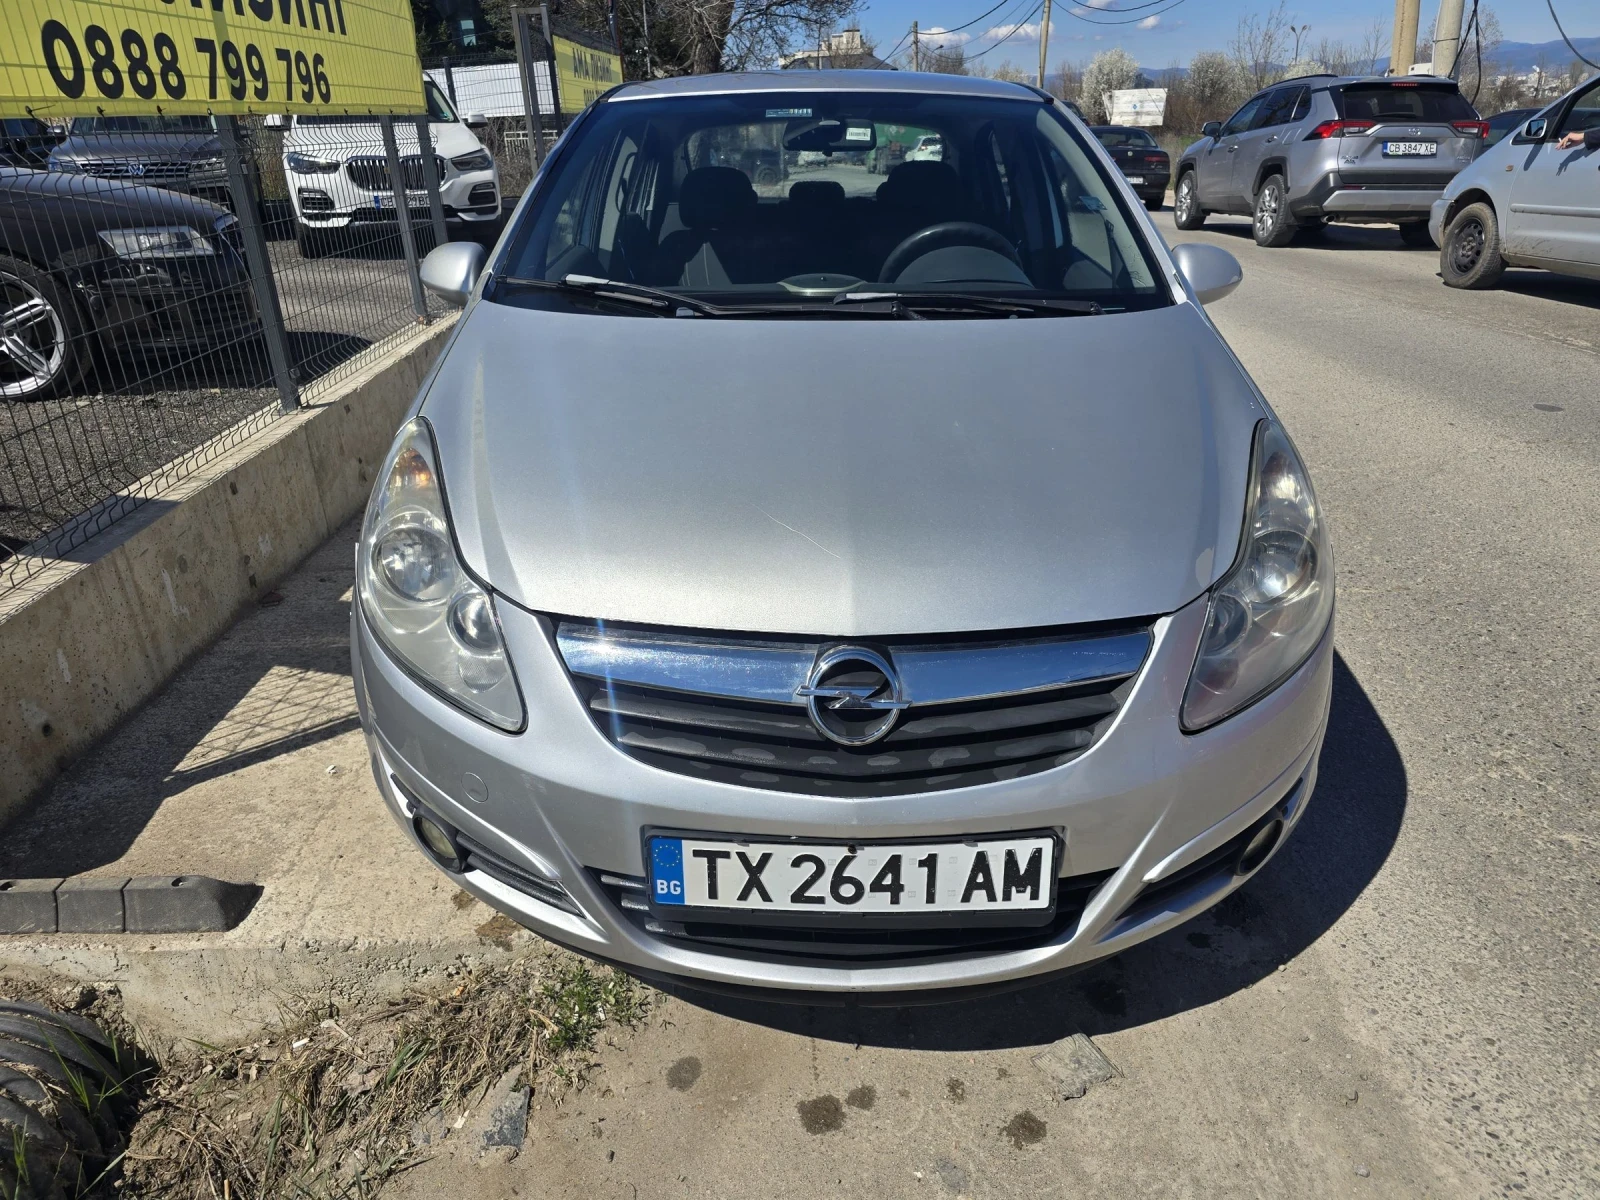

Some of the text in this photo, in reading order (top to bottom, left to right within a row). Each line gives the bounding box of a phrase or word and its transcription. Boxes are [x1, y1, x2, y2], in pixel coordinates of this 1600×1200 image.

[41, 19, 331, 105] 0888 799 796
[1402, 143, 1423, 153] 3847
[656, 879, 681, 895] BG
[691, 847, 1043, 905] TX 2641 AM
